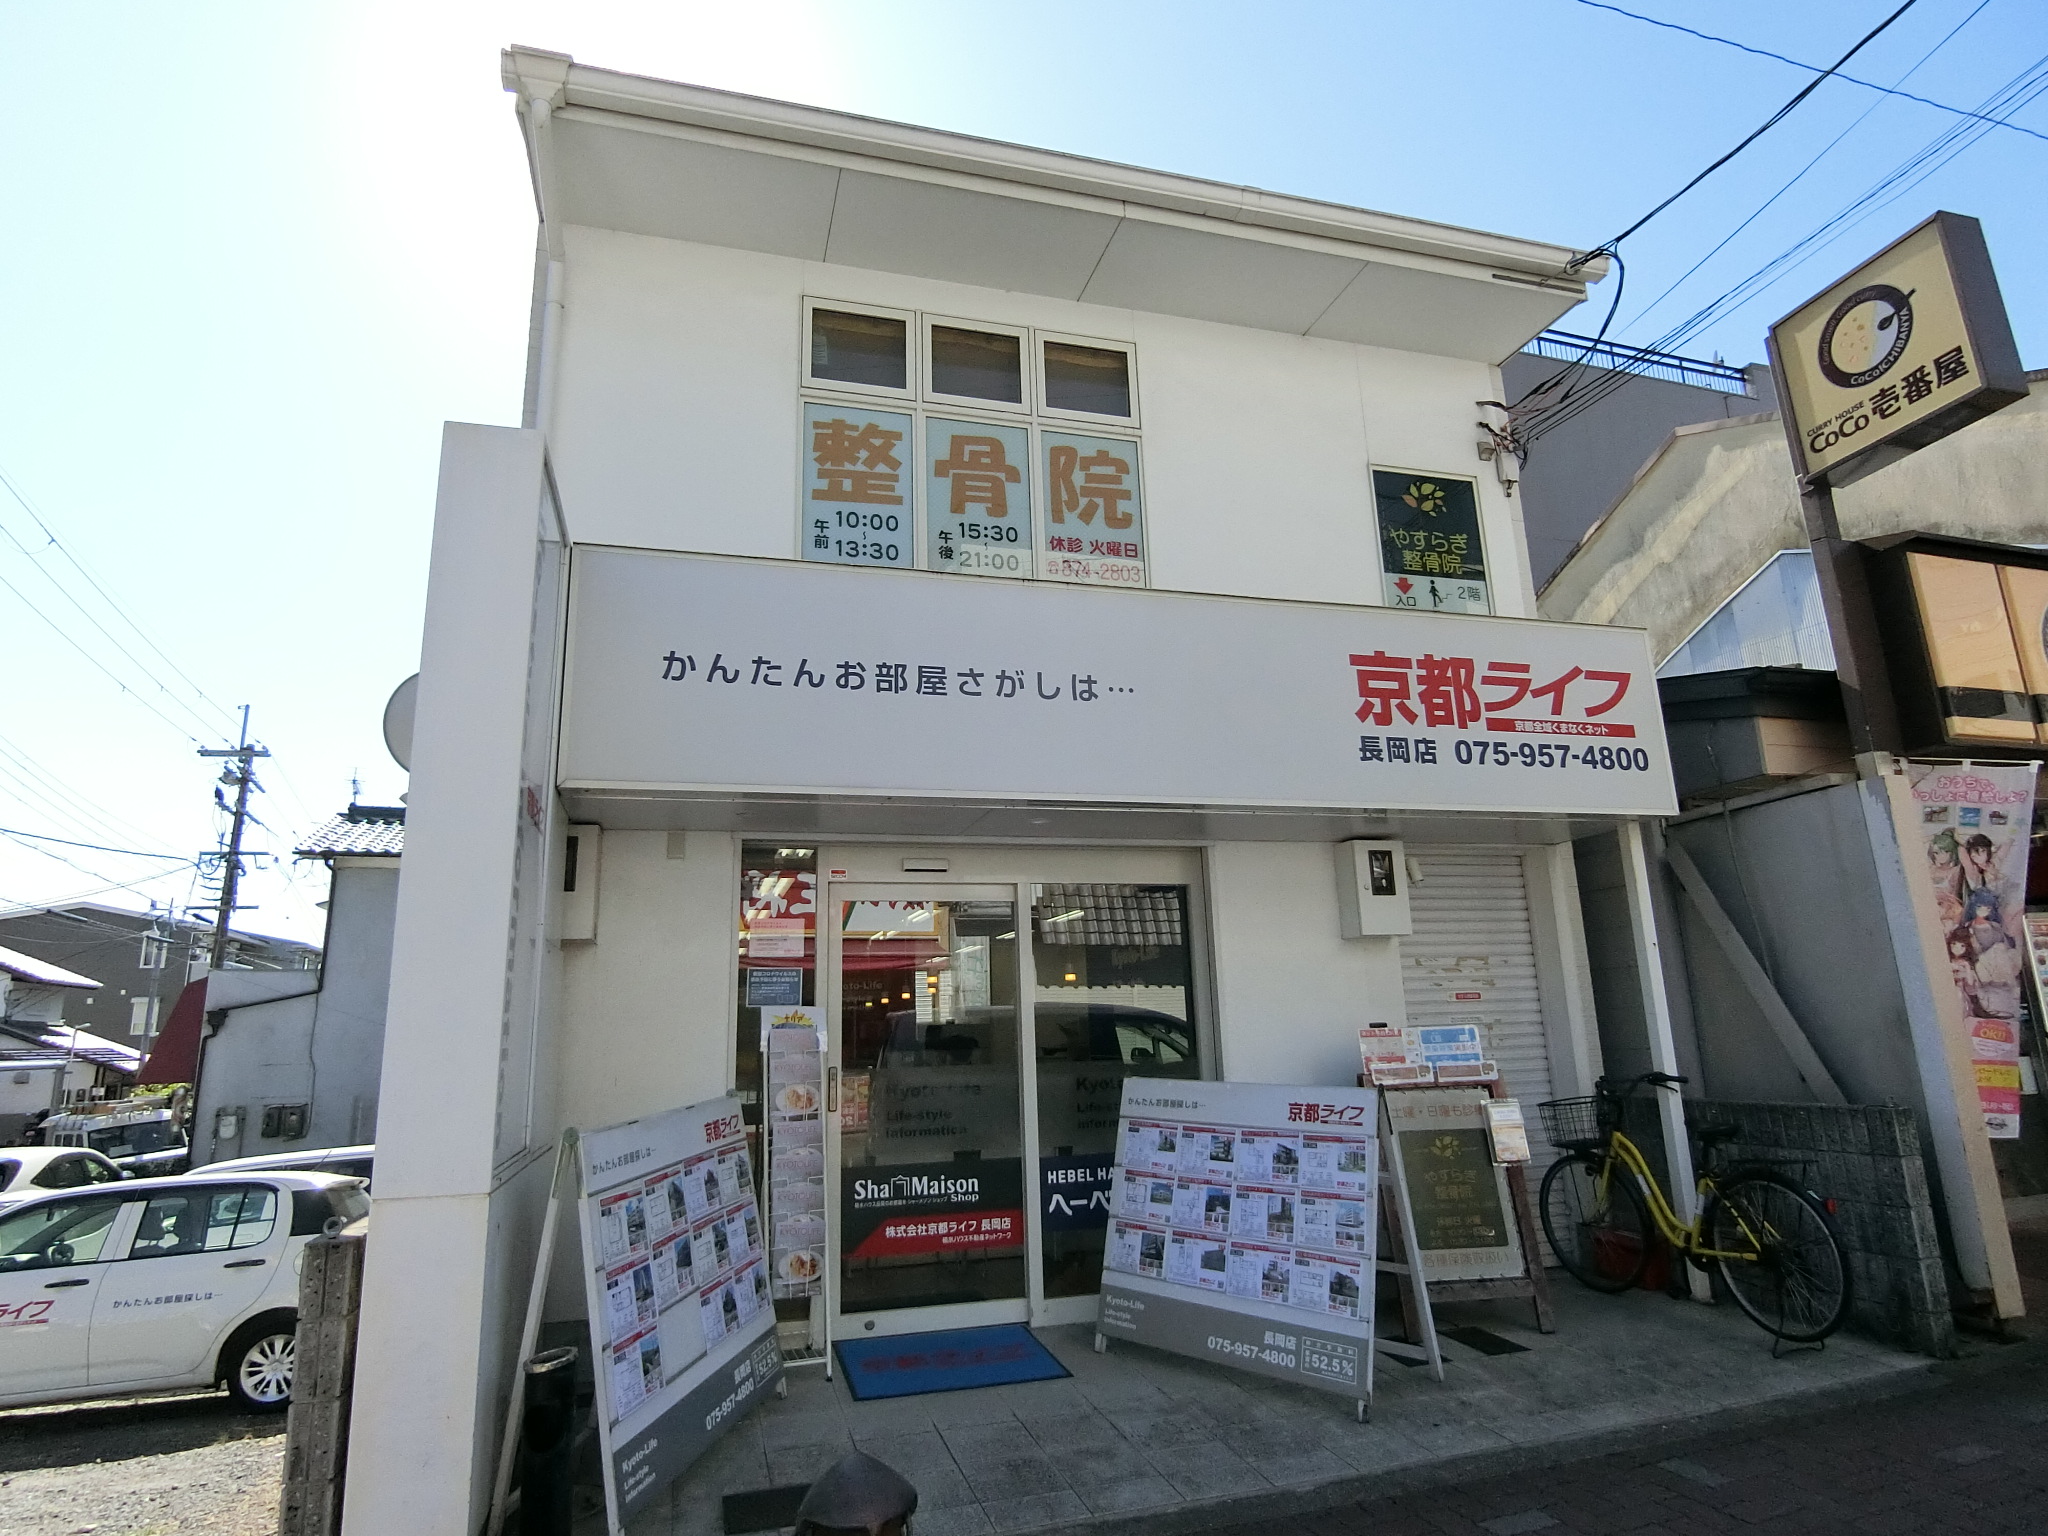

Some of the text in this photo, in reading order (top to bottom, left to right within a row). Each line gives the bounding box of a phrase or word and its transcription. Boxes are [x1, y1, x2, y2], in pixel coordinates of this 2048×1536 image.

[1850, 306, 1911, 386] CoCoICHIBANYA
[1806, 401, 1865, 438] CURRY HOUSE
[812, 418, 1134, 530] 整骨院
[835, 510, 899, 532] 10:00
[958, 522, 1019, 543] 15:30
[813, 518, 830, 550] 午前
[937, 529, 955, 561] 午後
[1388, 527, 1469, 554] やすらぎ
[835, 539, 900, 561] 13:30
[1049, 535, 1139, 558] 休診 火曜日
[959, 550, 1020, 572] 21:00
[1402, 549, 1464, 575] 整骨院
[1395, 594, 1417, 607] 入口
[1457, 586, 1481, 602] 2階
[1348, 650, 1632, 730] 京都ライフ
[1358, 735, 1650, 772] 長岡店 075-957-4800
[1288, 1101, 1365, 1123] 京都ライフ
[703, 1115, 740, 1144] 京都ライフ
[911, 1174, 980, 1198] Maison
[1047, 1169, 1094, 1184] HEBEL
[950, 1193, 980, 1203] Shop
[885, 1217, 1012, 1239] 株式会社京都ライフ 長岡店
[1106, 1294, 1145, 1311] Kyoto-Life
[1207, 1335, 1296, 1368] 075-957-4800
[1263, 1330, 1297, 1350] 長岡店
[1311, 1353, 1354, 1376] 52.5%
[706, 1376, 755, 1431] 075-957-4800
